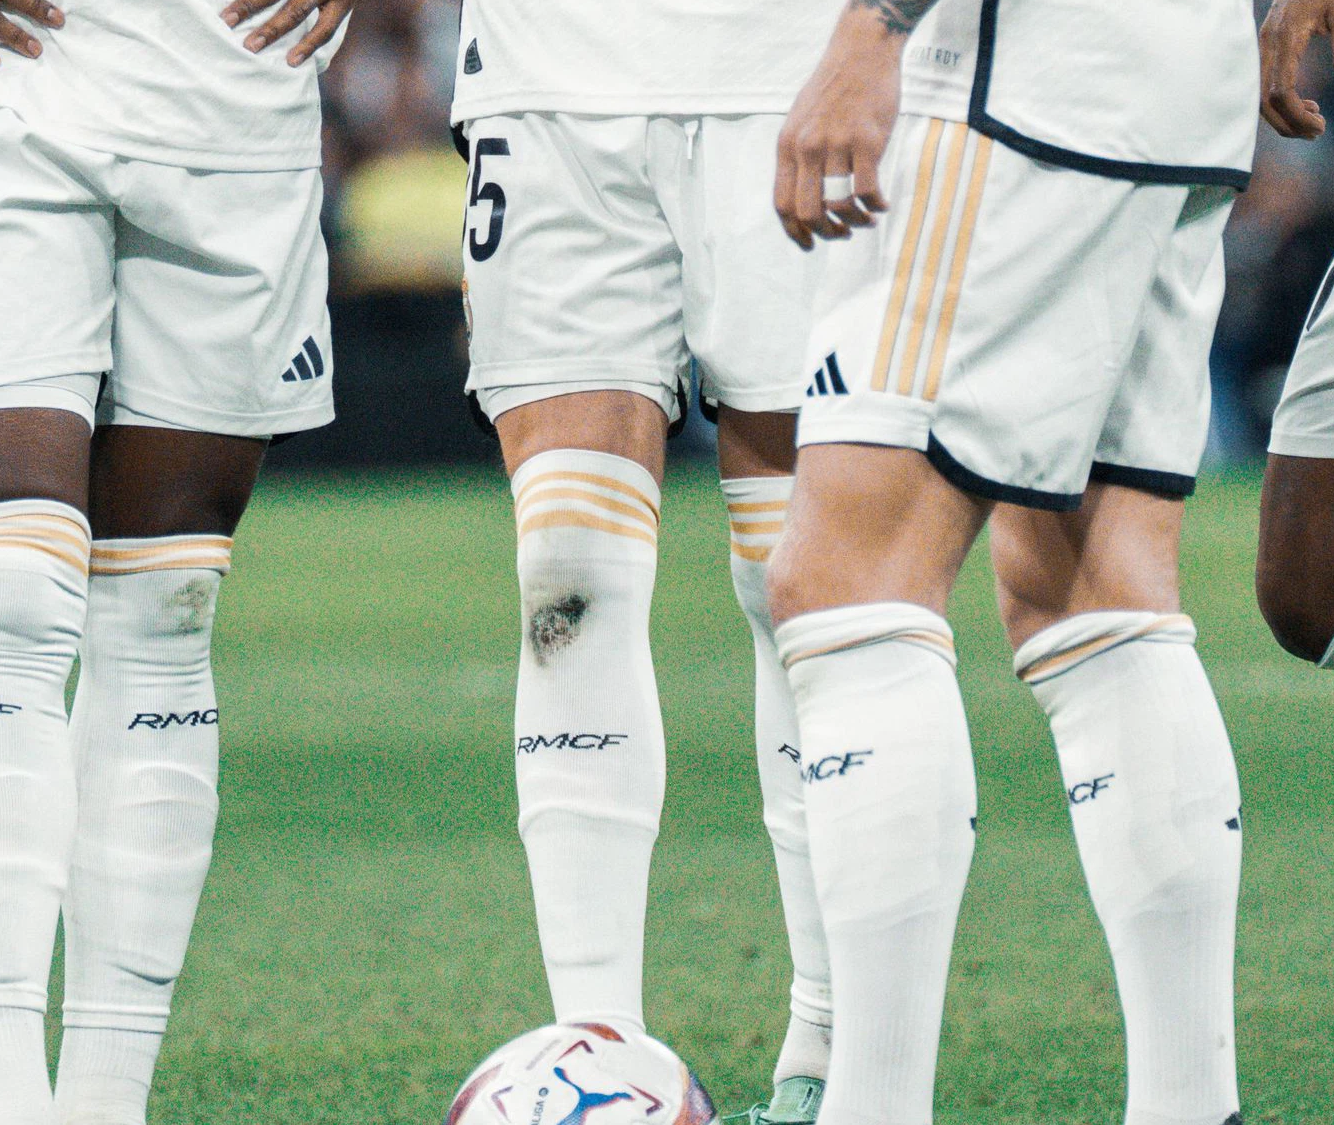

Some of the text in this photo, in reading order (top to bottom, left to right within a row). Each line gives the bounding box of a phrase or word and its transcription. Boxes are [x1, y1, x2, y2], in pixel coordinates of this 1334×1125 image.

[464, 137, 511, 262] 5
[128, 707, 219, 730] RMC
[517, 733, 628, 755] RMCF
